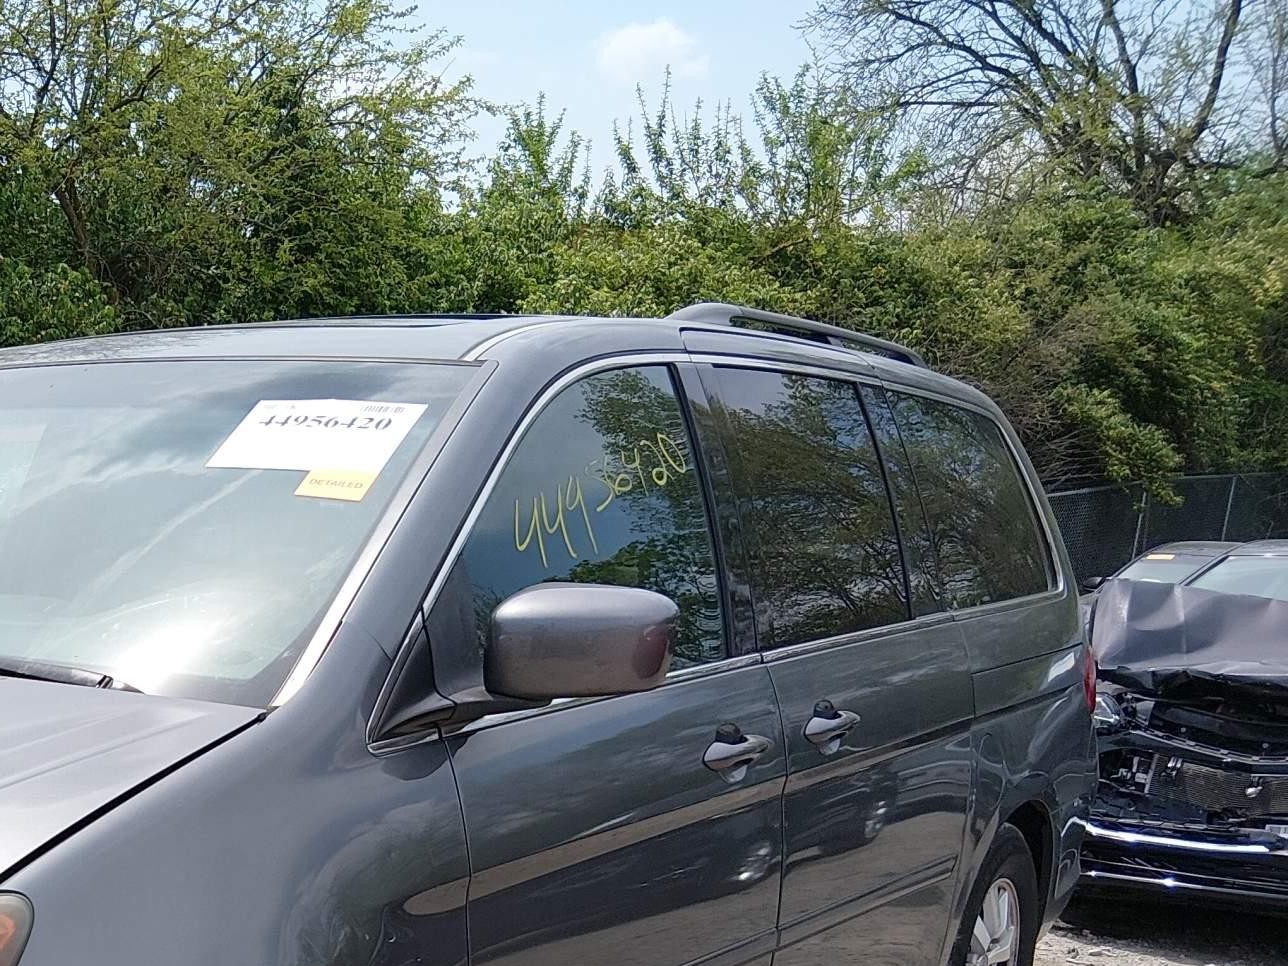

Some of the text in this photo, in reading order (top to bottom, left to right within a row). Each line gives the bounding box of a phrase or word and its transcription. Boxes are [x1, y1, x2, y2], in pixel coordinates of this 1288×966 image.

[259, 415, 393, 431] 44956420
[309, 477, 366, 490] DETAILED
[515, 431, 687, 569] 44956420
